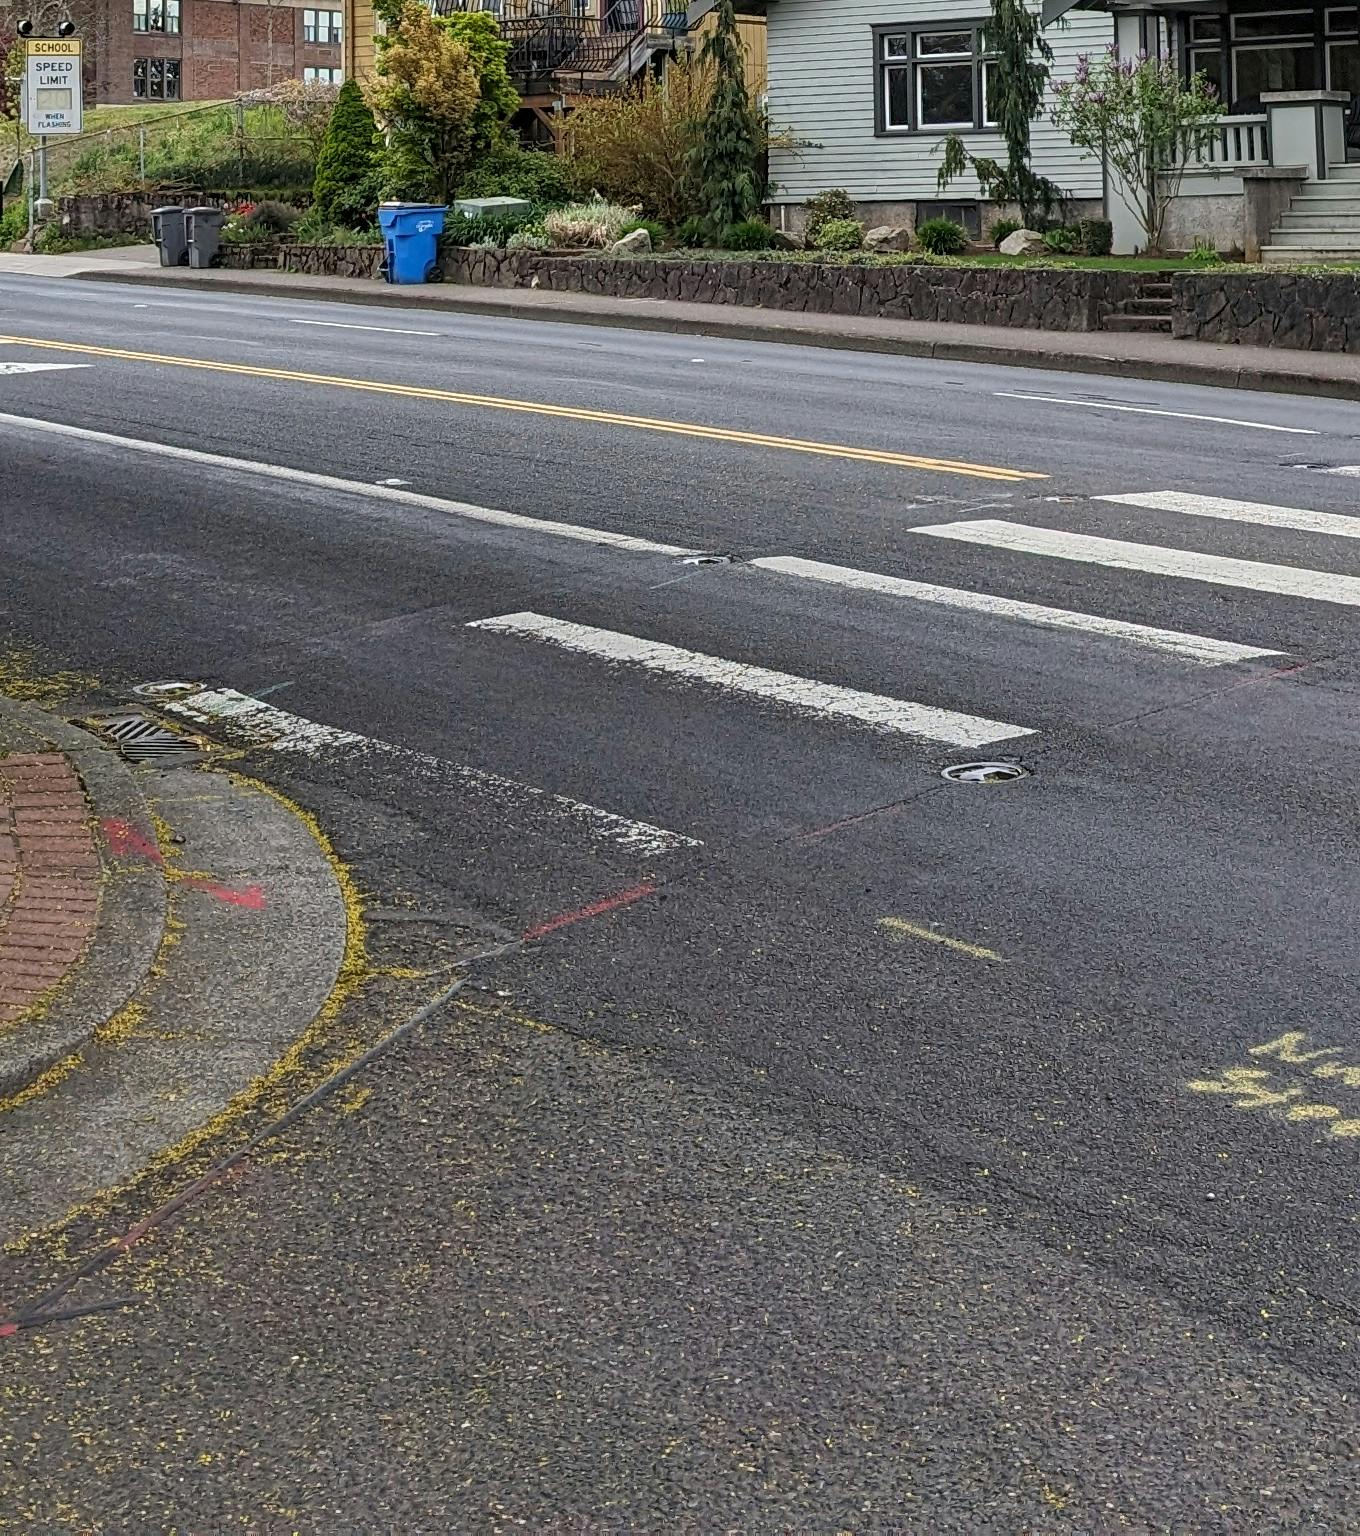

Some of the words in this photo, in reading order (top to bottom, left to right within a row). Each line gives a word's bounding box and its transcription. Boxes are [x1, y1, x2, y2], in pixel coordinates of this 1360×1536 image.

[34, 42, 74, 52] SCHOOL
[35, 62, 73, 72] SPEED
[40, 75, 68, 85] LIMIT
